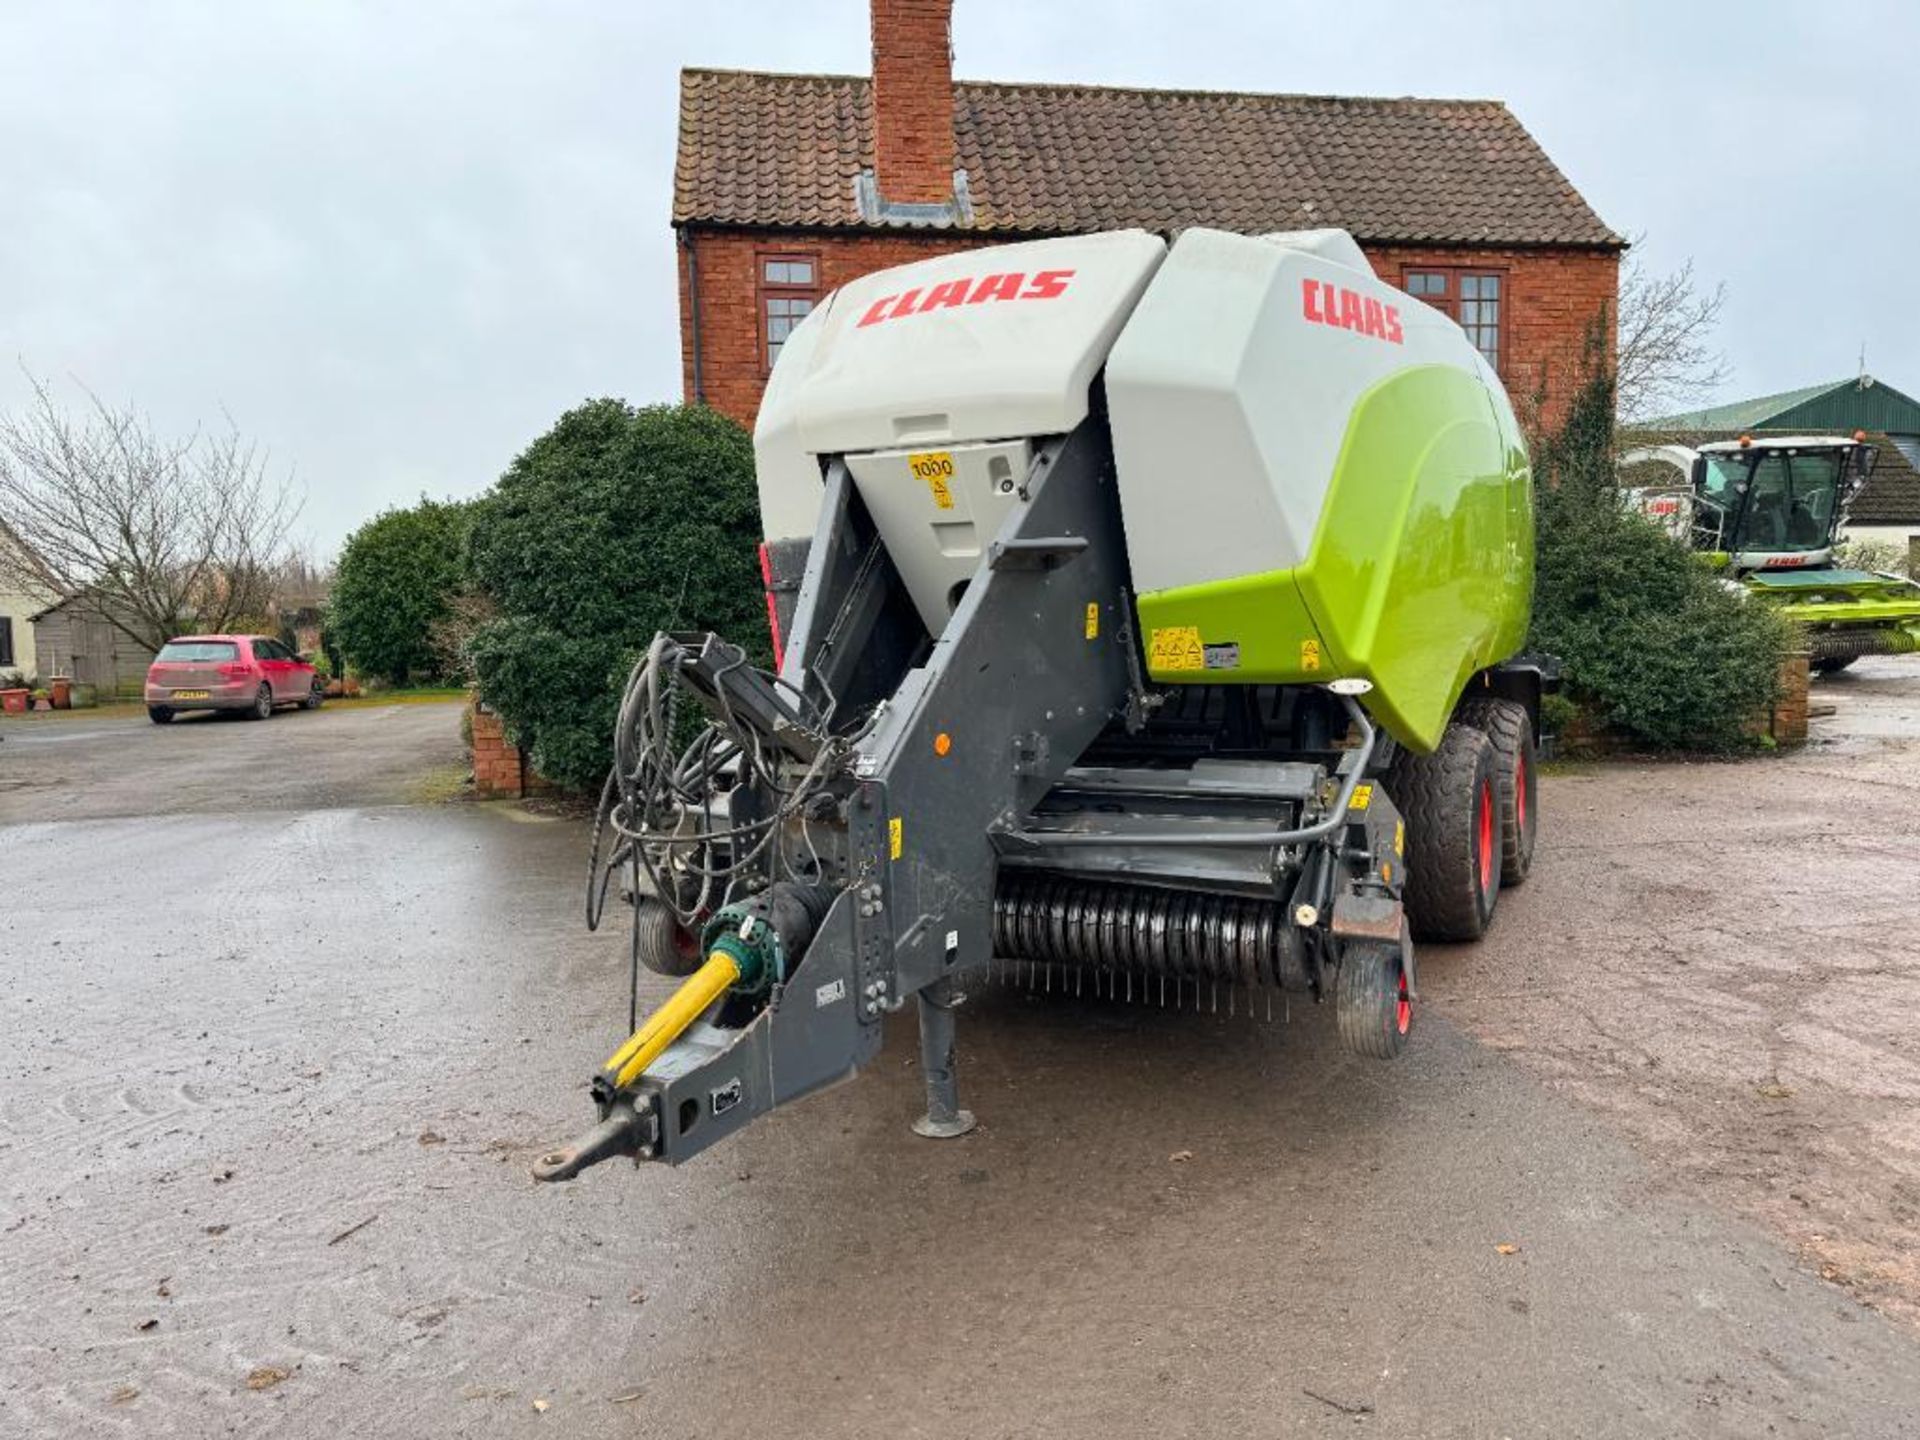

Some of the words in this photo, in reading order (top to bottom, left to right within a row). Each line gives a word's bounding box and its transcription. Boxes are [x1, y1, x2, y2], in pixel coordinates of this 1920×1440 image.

[856, 270, 1076, 328] CLAAS
[1303, 279, 1403, 345] CLAAS
[912, 460, 952, 476] 1000
